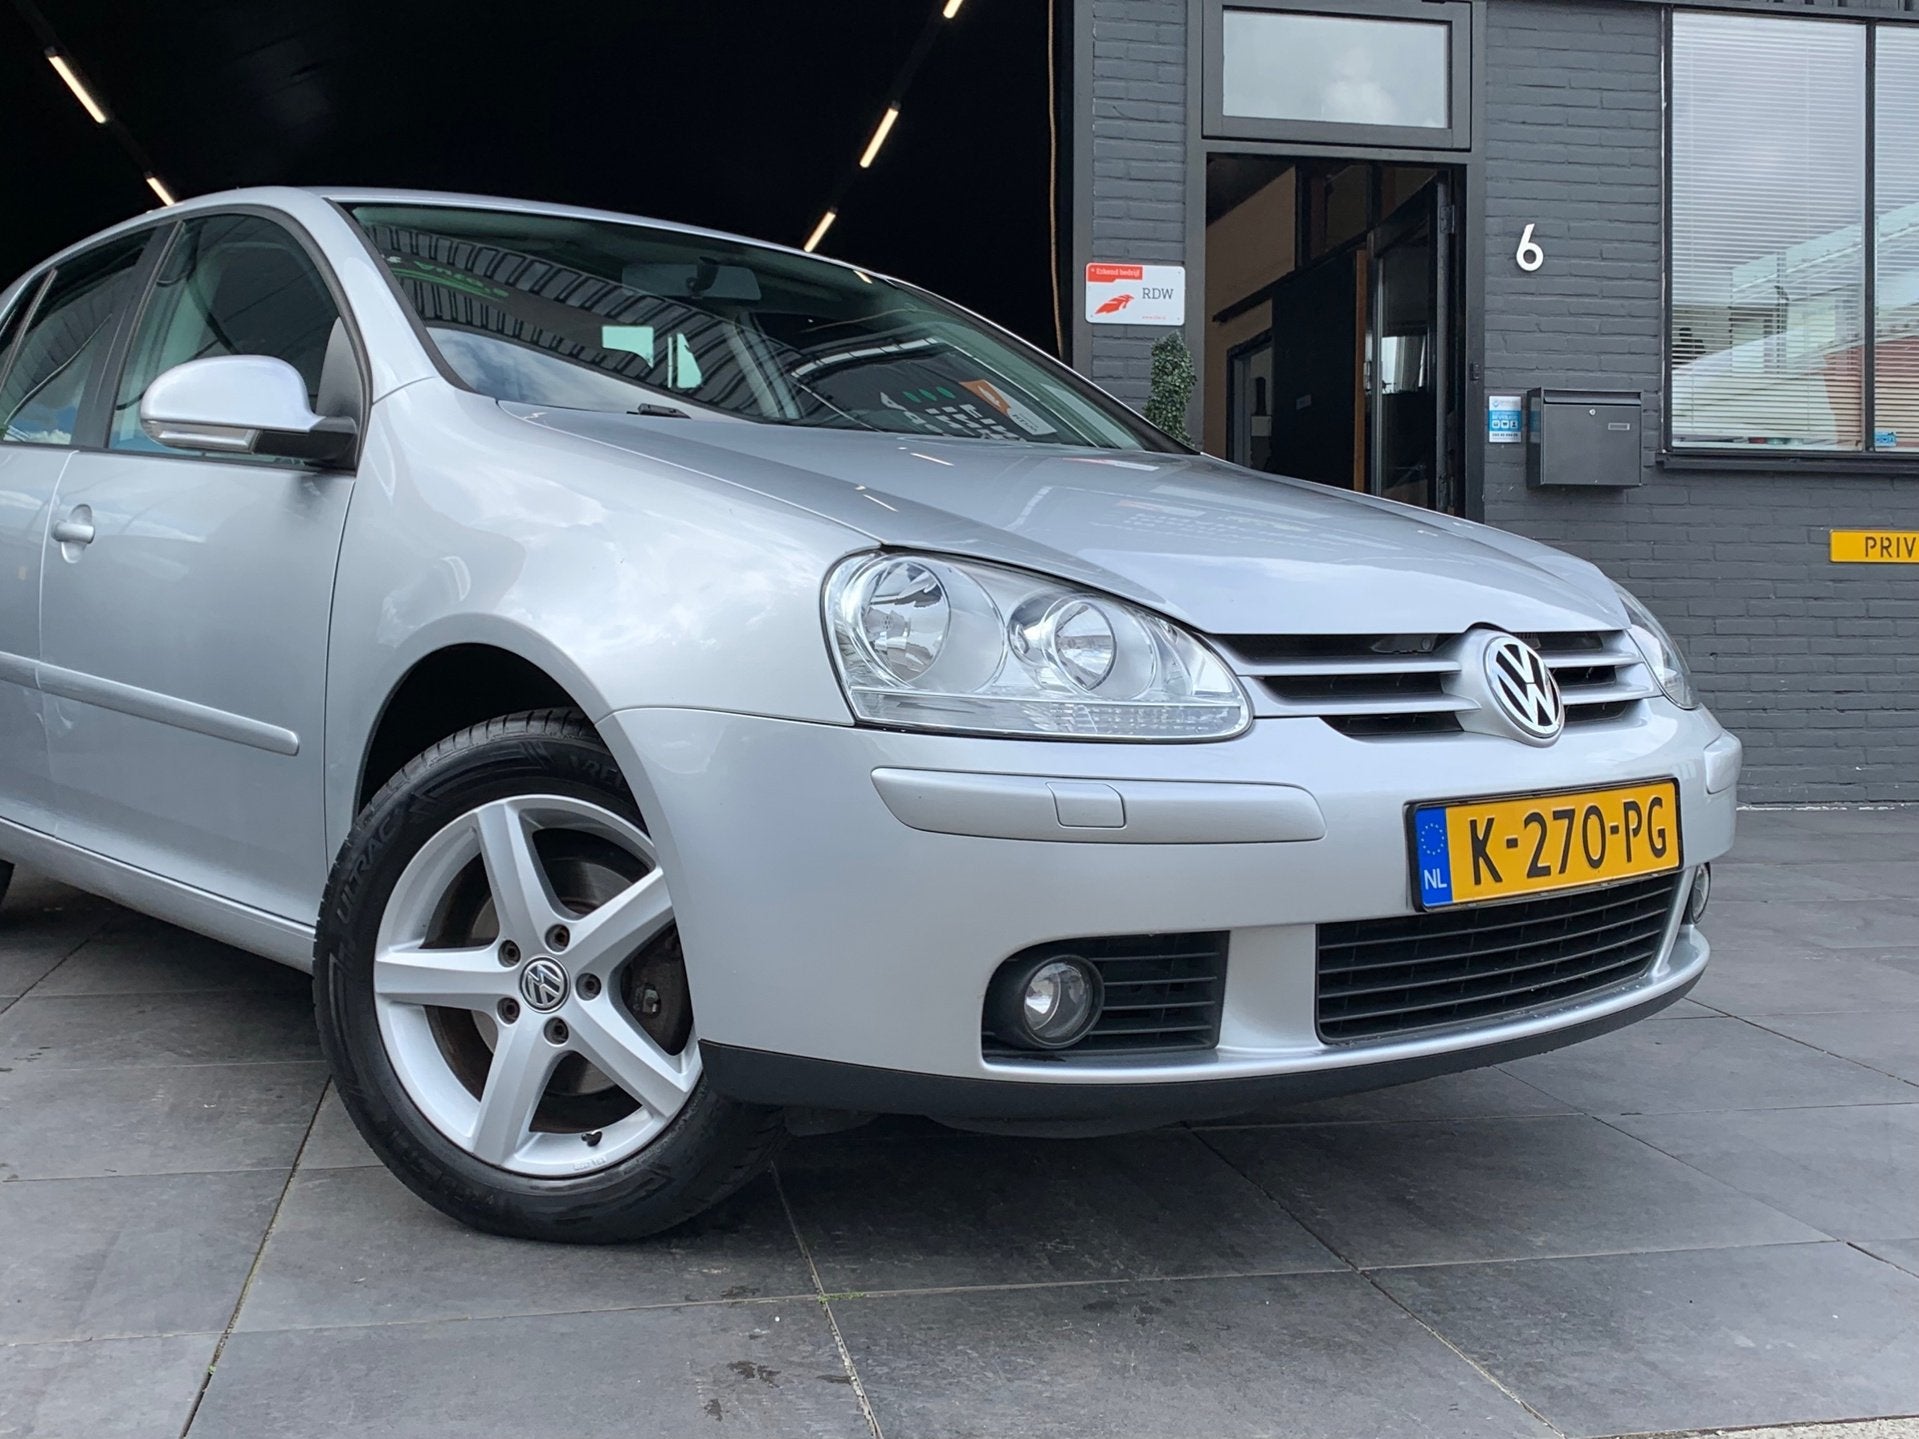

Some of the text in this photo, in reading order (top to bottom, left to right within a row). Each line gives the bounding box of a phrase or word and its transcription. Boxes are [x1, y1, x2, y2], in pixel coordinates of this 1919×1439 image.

[1515, 223, 1544, 272] 6
[1142, 287, 1174, 300] RDW
[1468, 796, 1668, 887] K-270-PG
[1423, 868, 1448, 890] NL
